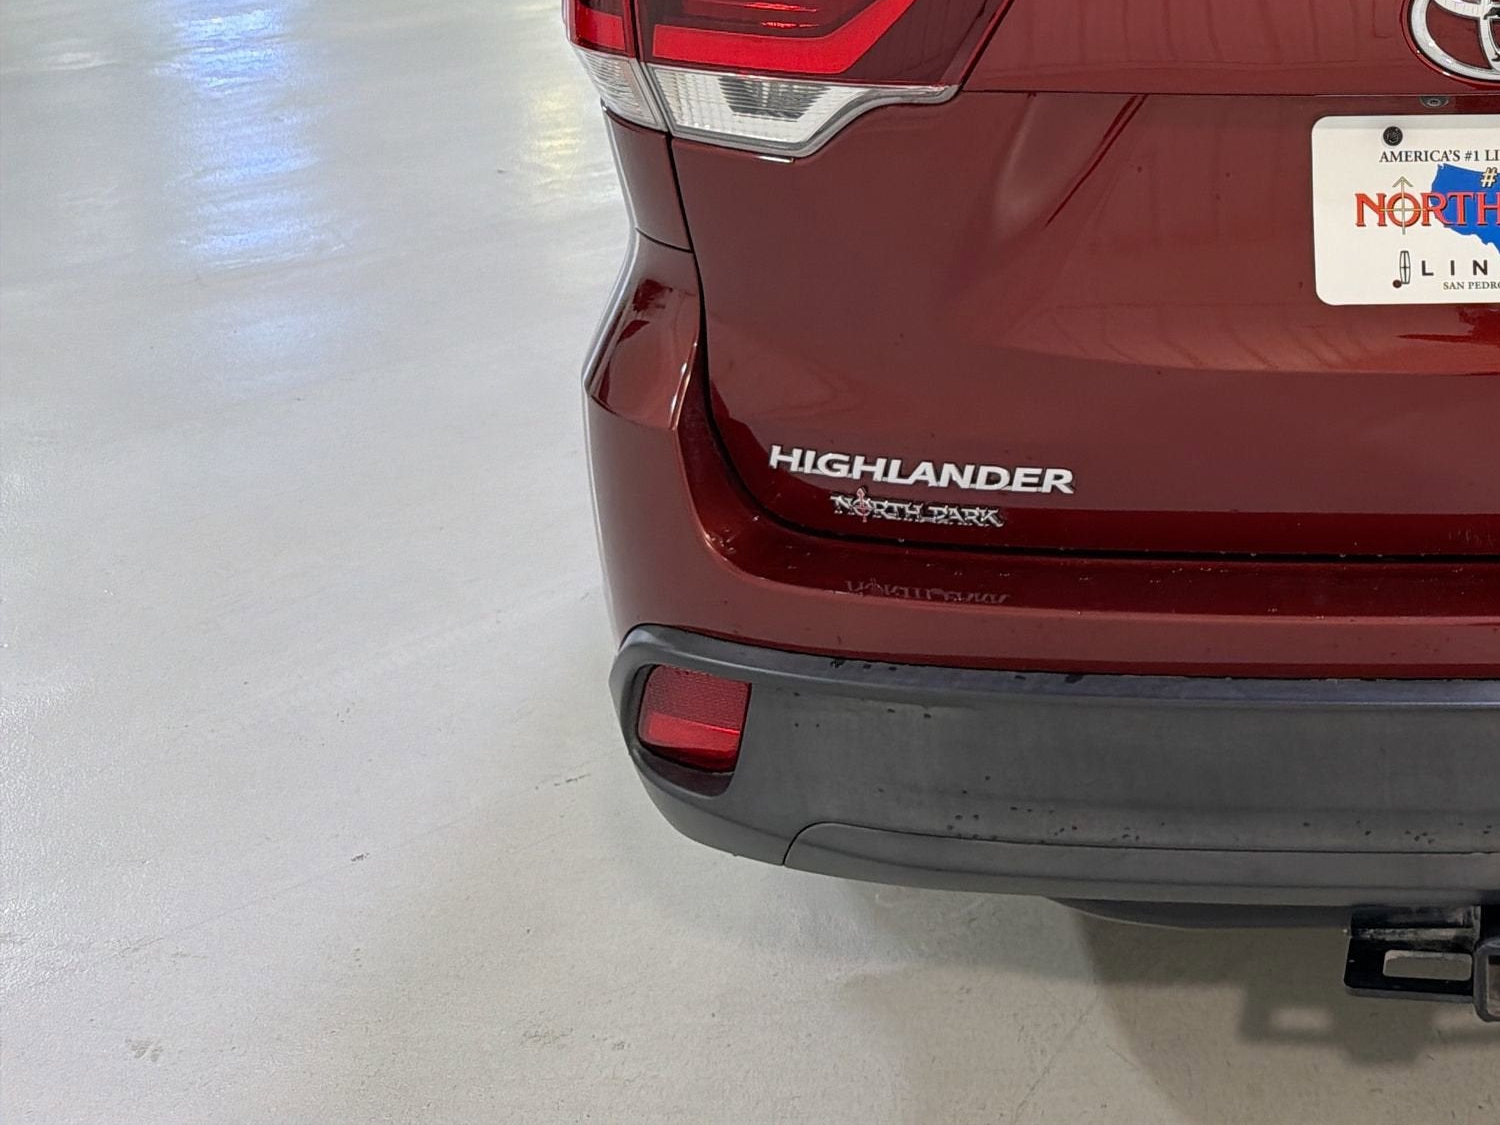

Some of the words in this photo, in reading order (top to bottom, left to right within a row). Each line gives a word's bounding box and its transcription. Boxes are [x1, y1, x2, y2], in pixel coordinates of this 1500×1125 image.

[1379, 149, 1461, 163] AMERICA'S
[1464, 149, 1480, 162] #1
[1442, 280, 1464, 290] SAN
[768, 444, 1077, 495] HIGHLANDER
[829, 494, 924, 524] NORTH
[927, 504, 1004, 527] PARK
